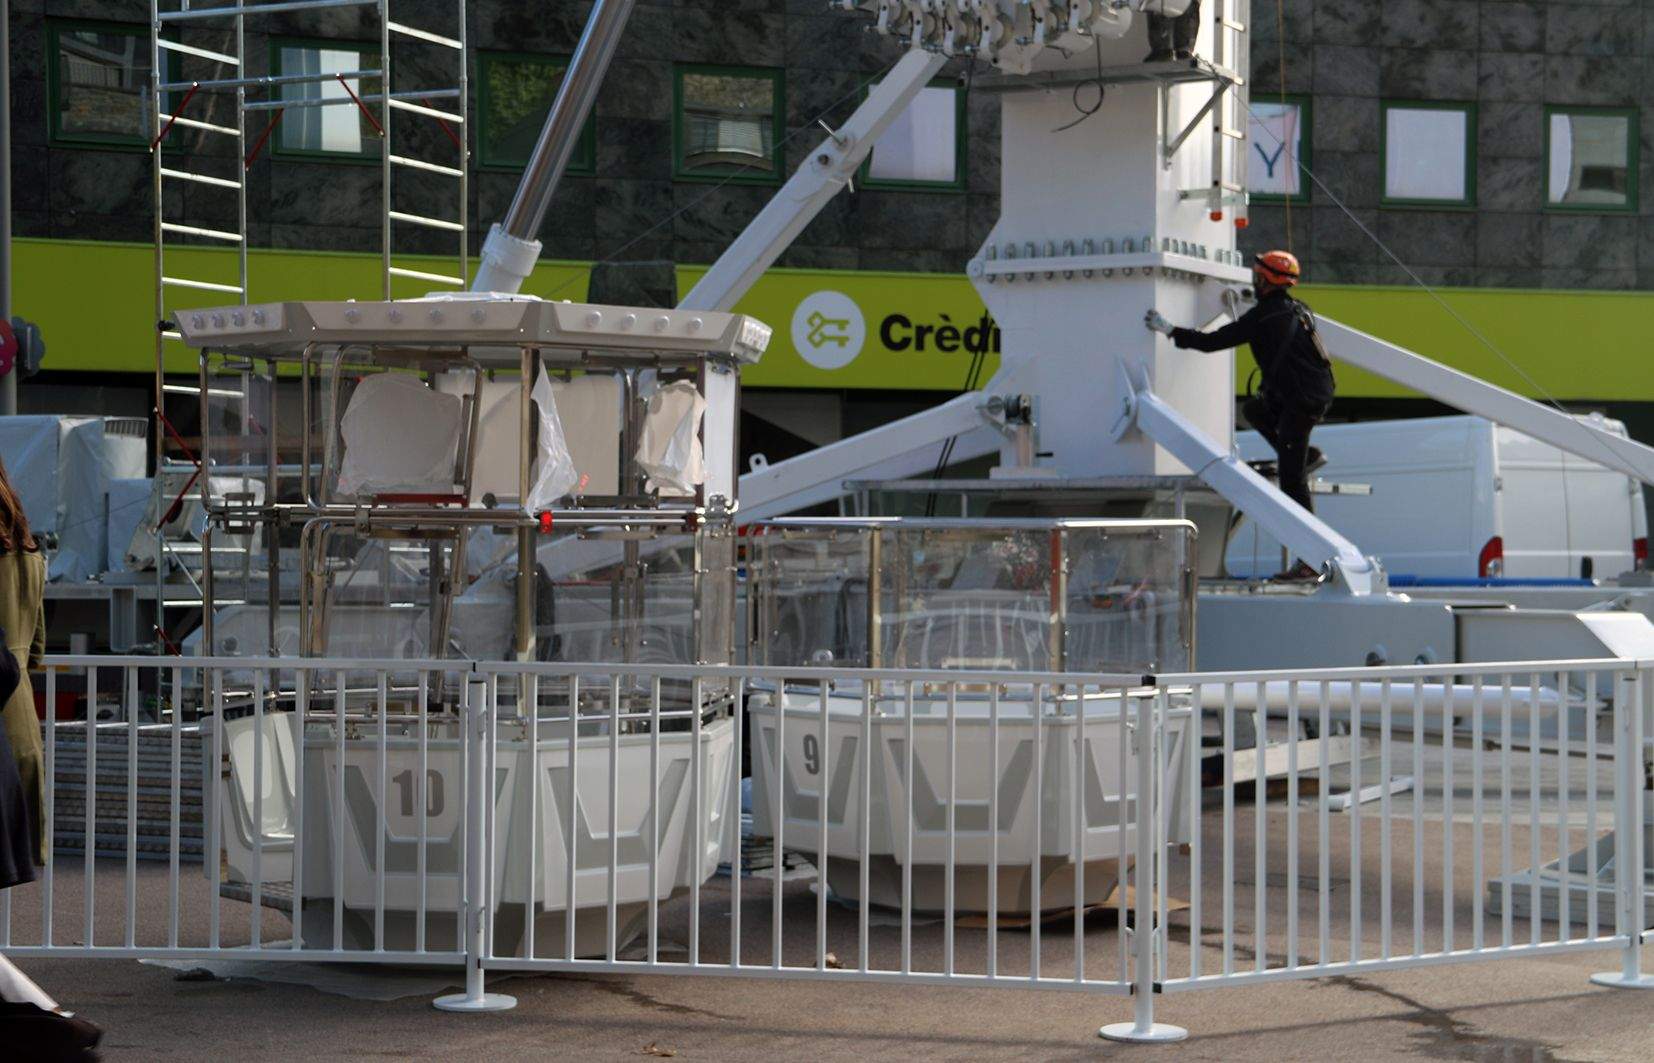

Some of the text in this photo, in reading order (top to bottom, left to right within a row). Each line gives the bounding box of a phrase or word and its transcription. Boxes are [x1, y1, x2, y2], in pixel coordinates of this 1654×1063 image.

[1254, 142, 1285, 178] Y
[803, 734, 819, 775] 9
[392, 769, 445, 817] 10
